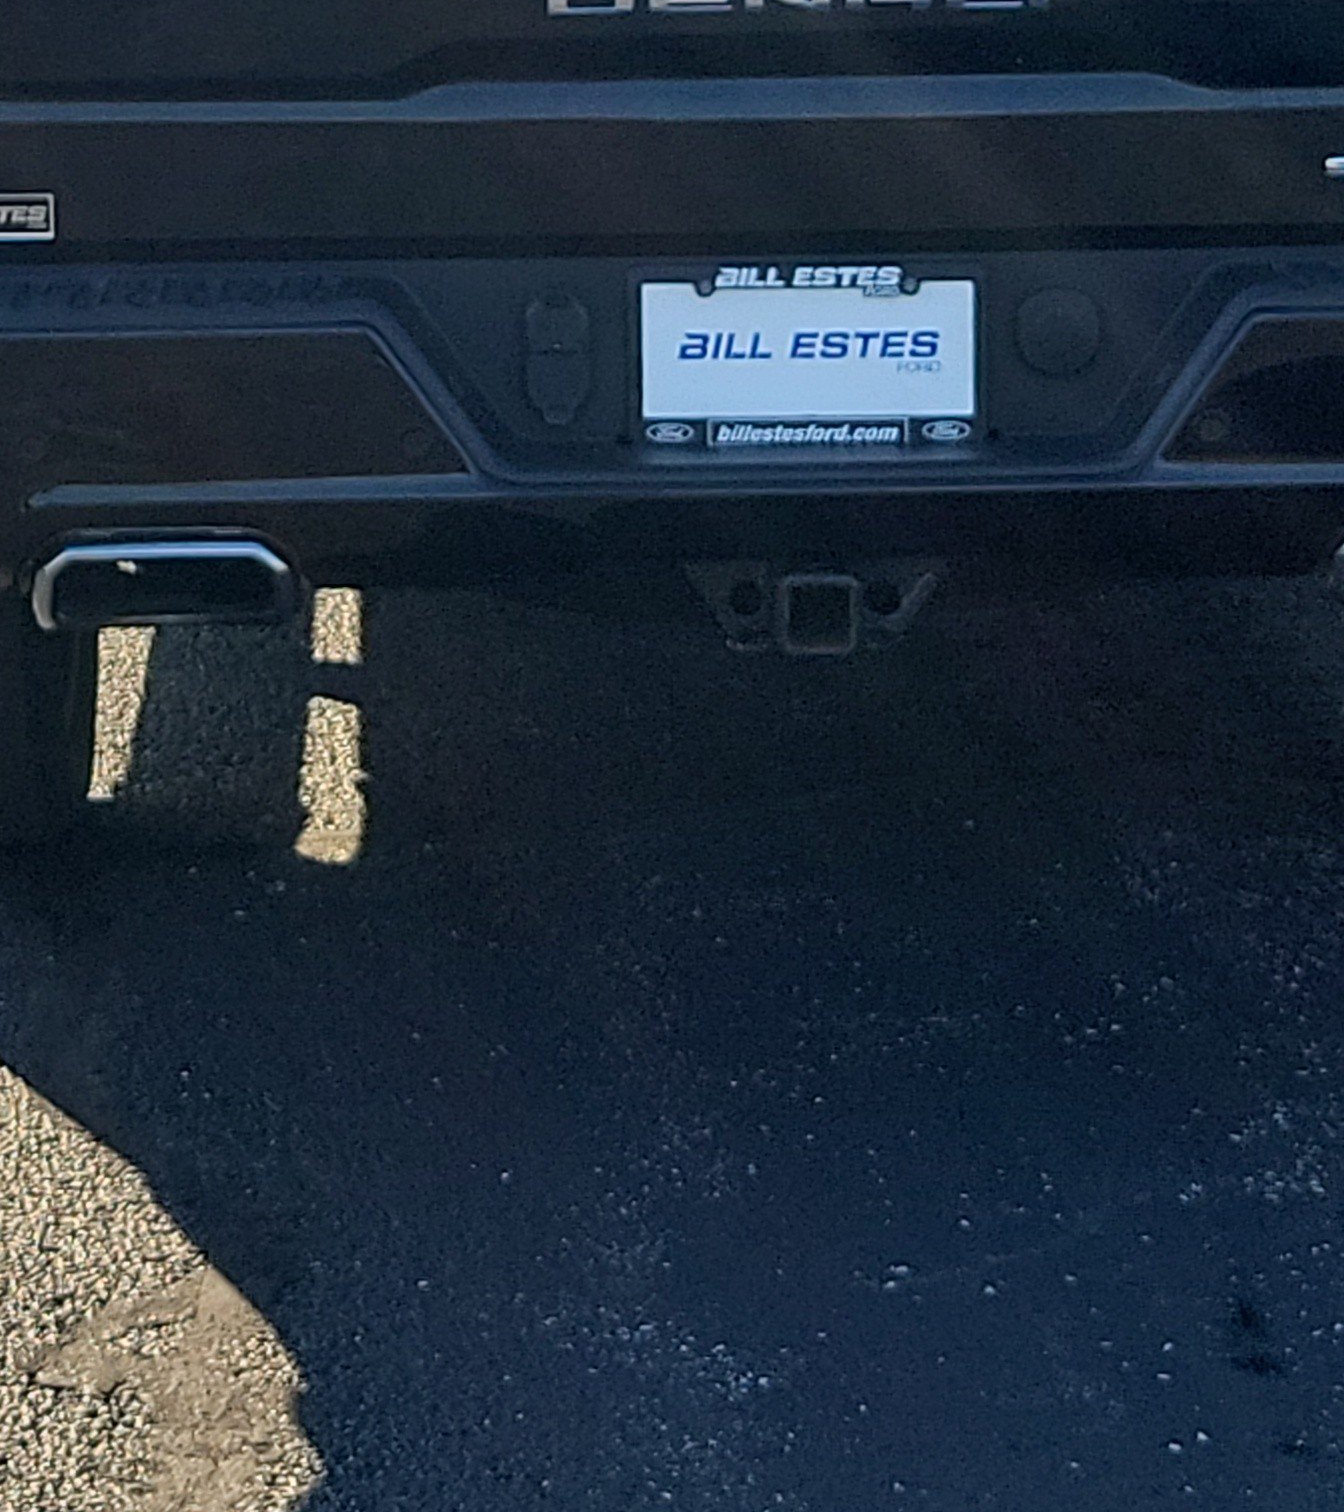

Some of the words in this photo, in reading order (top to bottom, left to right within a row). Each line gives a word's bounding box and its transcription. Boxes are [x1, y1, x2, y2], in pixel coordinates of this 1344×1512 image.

[714, 267, 785, 287] BILL
[792, 266, 904, 287] ESTES
[678, 332, 773, 359] BILL
[789, 330, 941, 359] ESTES
[716, 423, 899, 443] billestesford.com
